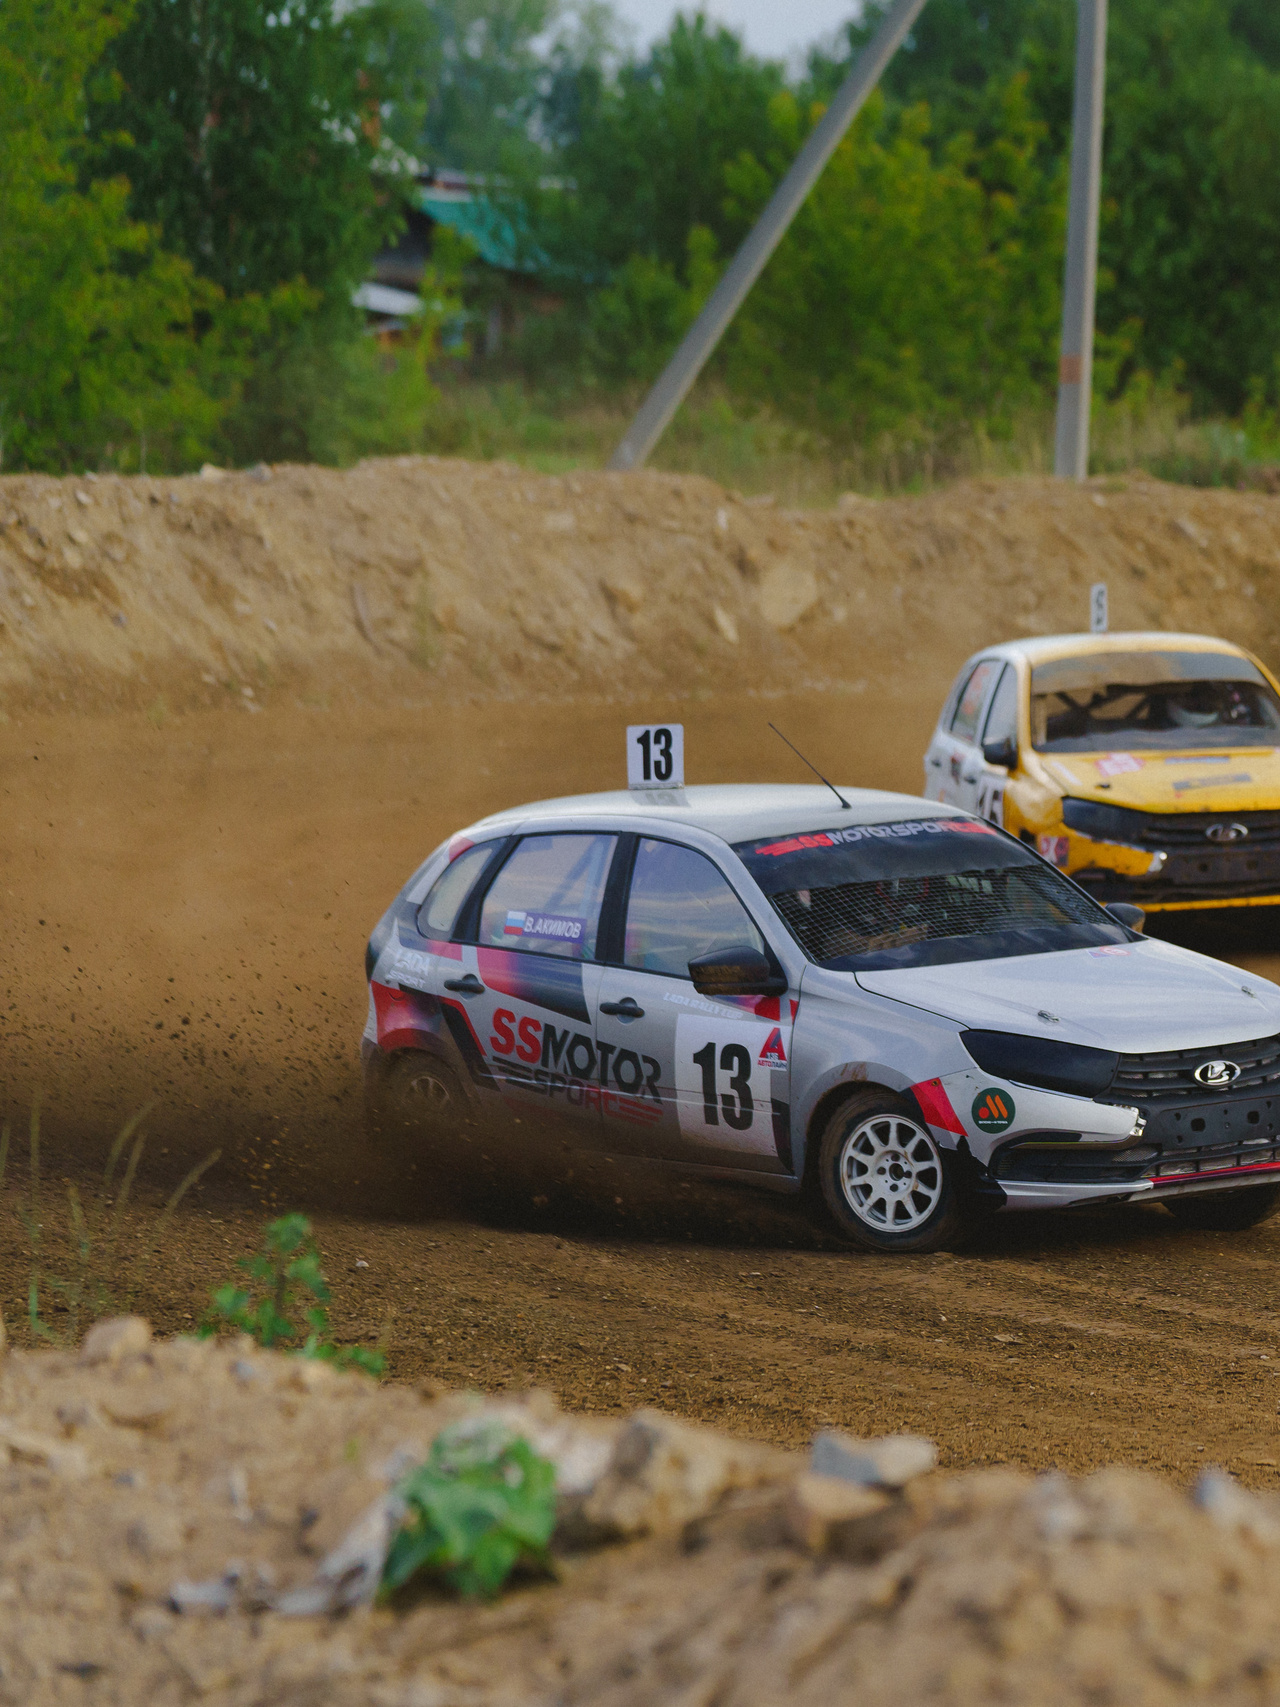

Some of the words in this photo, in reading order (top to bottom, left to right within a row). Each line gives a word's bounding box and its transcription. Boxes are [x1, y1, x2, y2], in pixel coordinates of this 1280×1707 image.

[636, 728, 673, 782] 13
[523, 916, 582, 939] В.АКИМОВ
[385, 970, 426, 988] SPORT
[489, 1007, 664, 1105] SSMOTOR
[692, 1041, 754, 1131] 13
